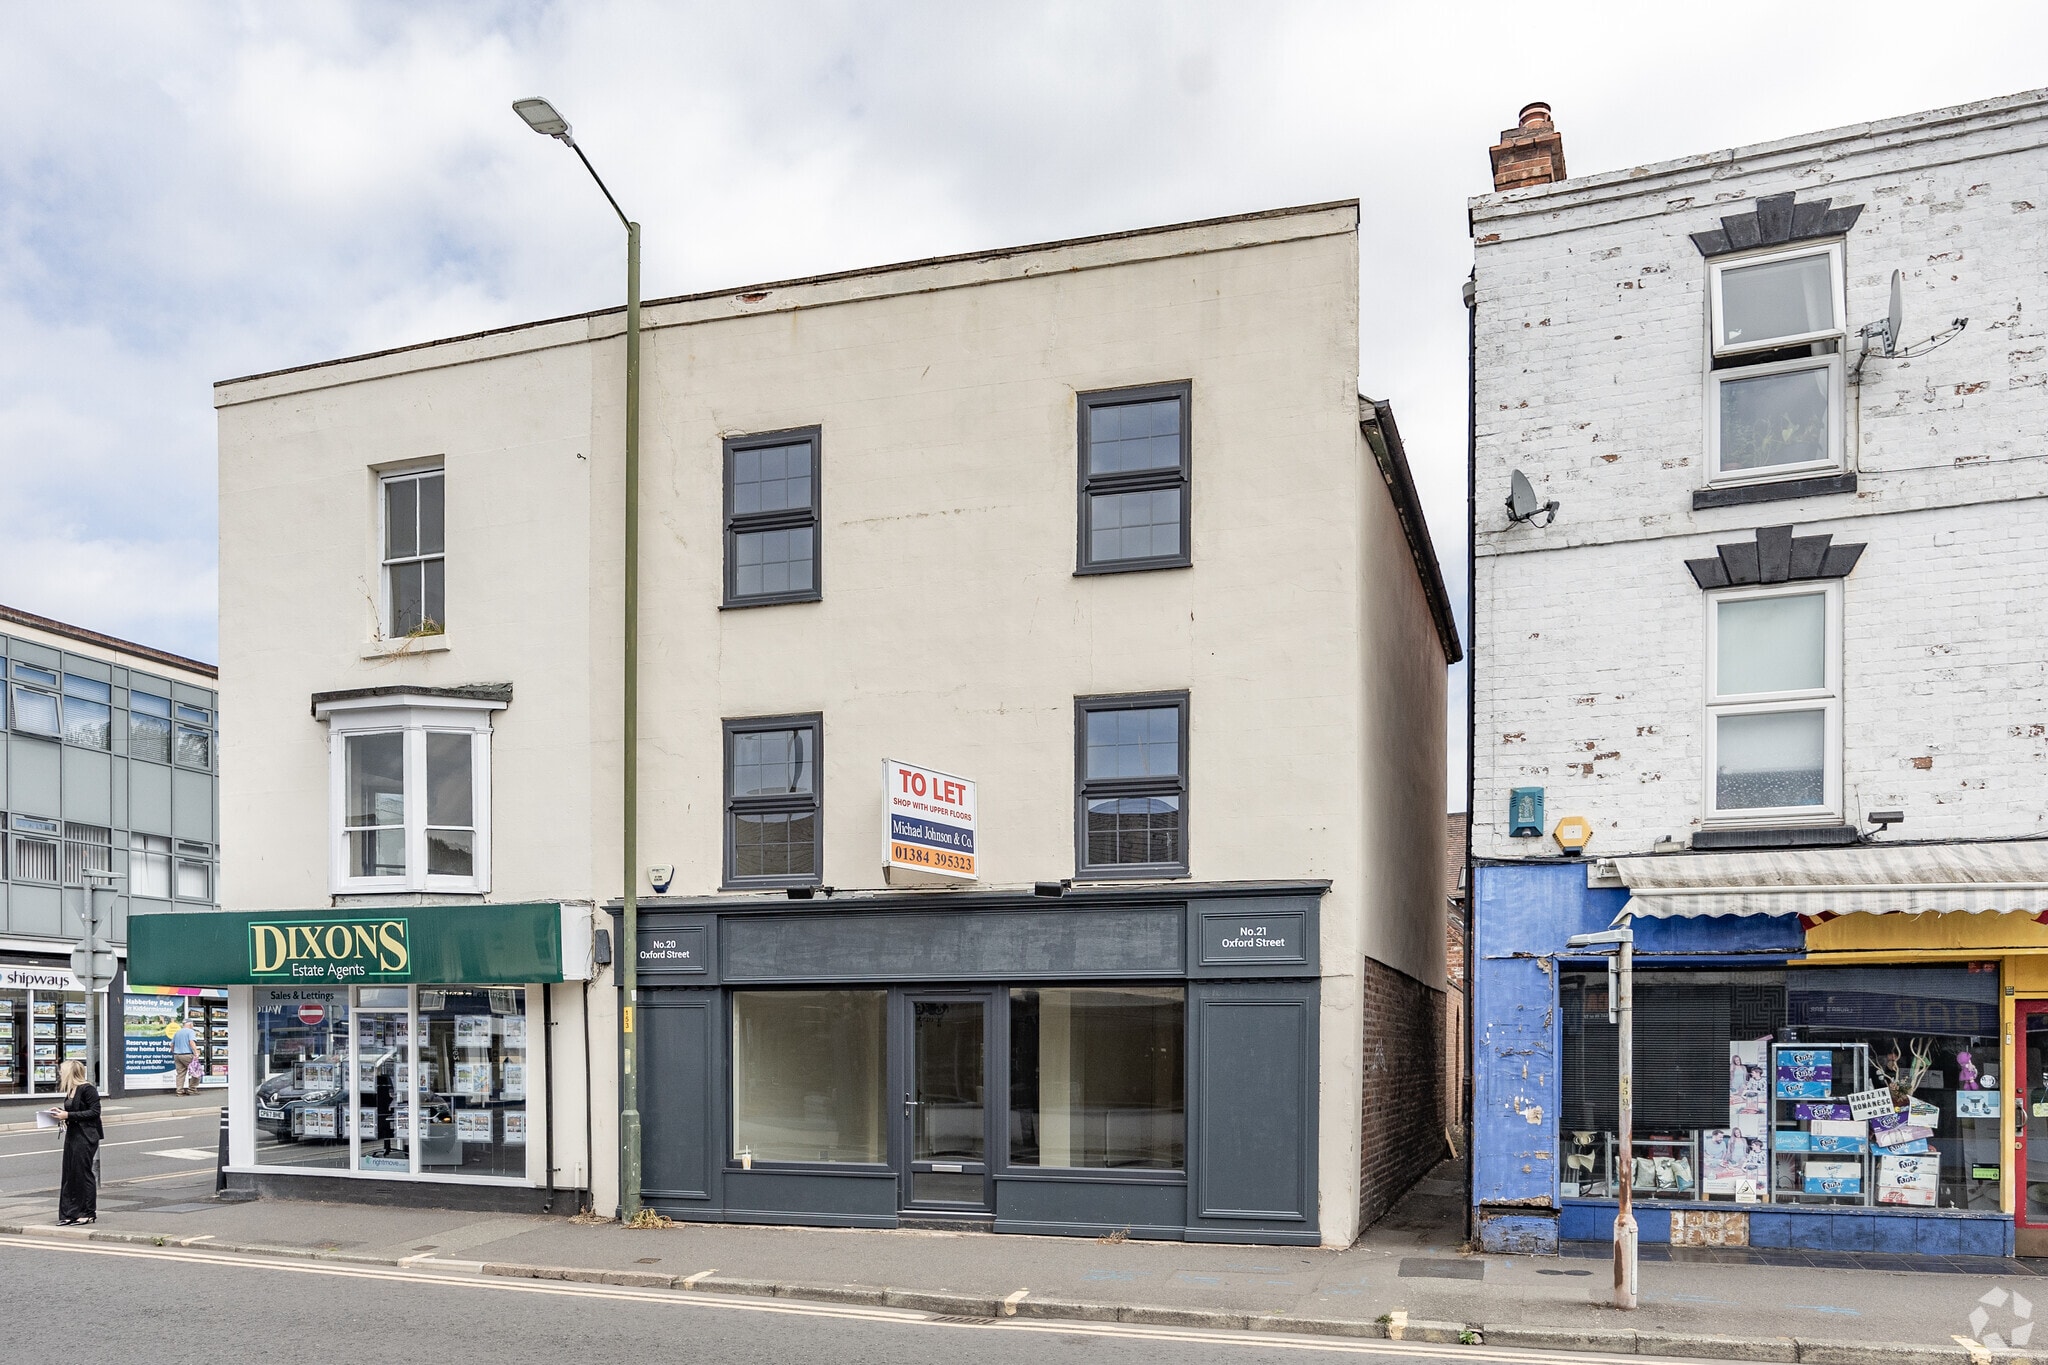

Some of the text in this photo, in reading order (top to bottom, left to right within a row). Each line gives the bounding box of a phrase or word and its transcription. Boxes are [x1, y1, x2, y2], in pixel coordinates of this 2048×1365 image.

[899, 768, 966, 806] TO LET
[893, 797, 971, 821] SHOP WITH UPPER FLOORS
[893, 820, 973, 848] Michael Johnson & Co.
[895, 846, 971, 870] 01384 395323
[1240, 927, 1267, 936] No.21
[250, 921, 408, 972] DIXONS
[653, 940, 676, 949] No.20
[1222, 938, 1285, 948] Oxford Street
[640, 950, 690, 959] Oxford Street
[292, 963, 365, 979] Estate Agents
[7, 971, 70, 989] shipways
[271, 991, 334, 1002] Sales & Lettings
[1853, 1098, 1891, 1111] ROMANESC
